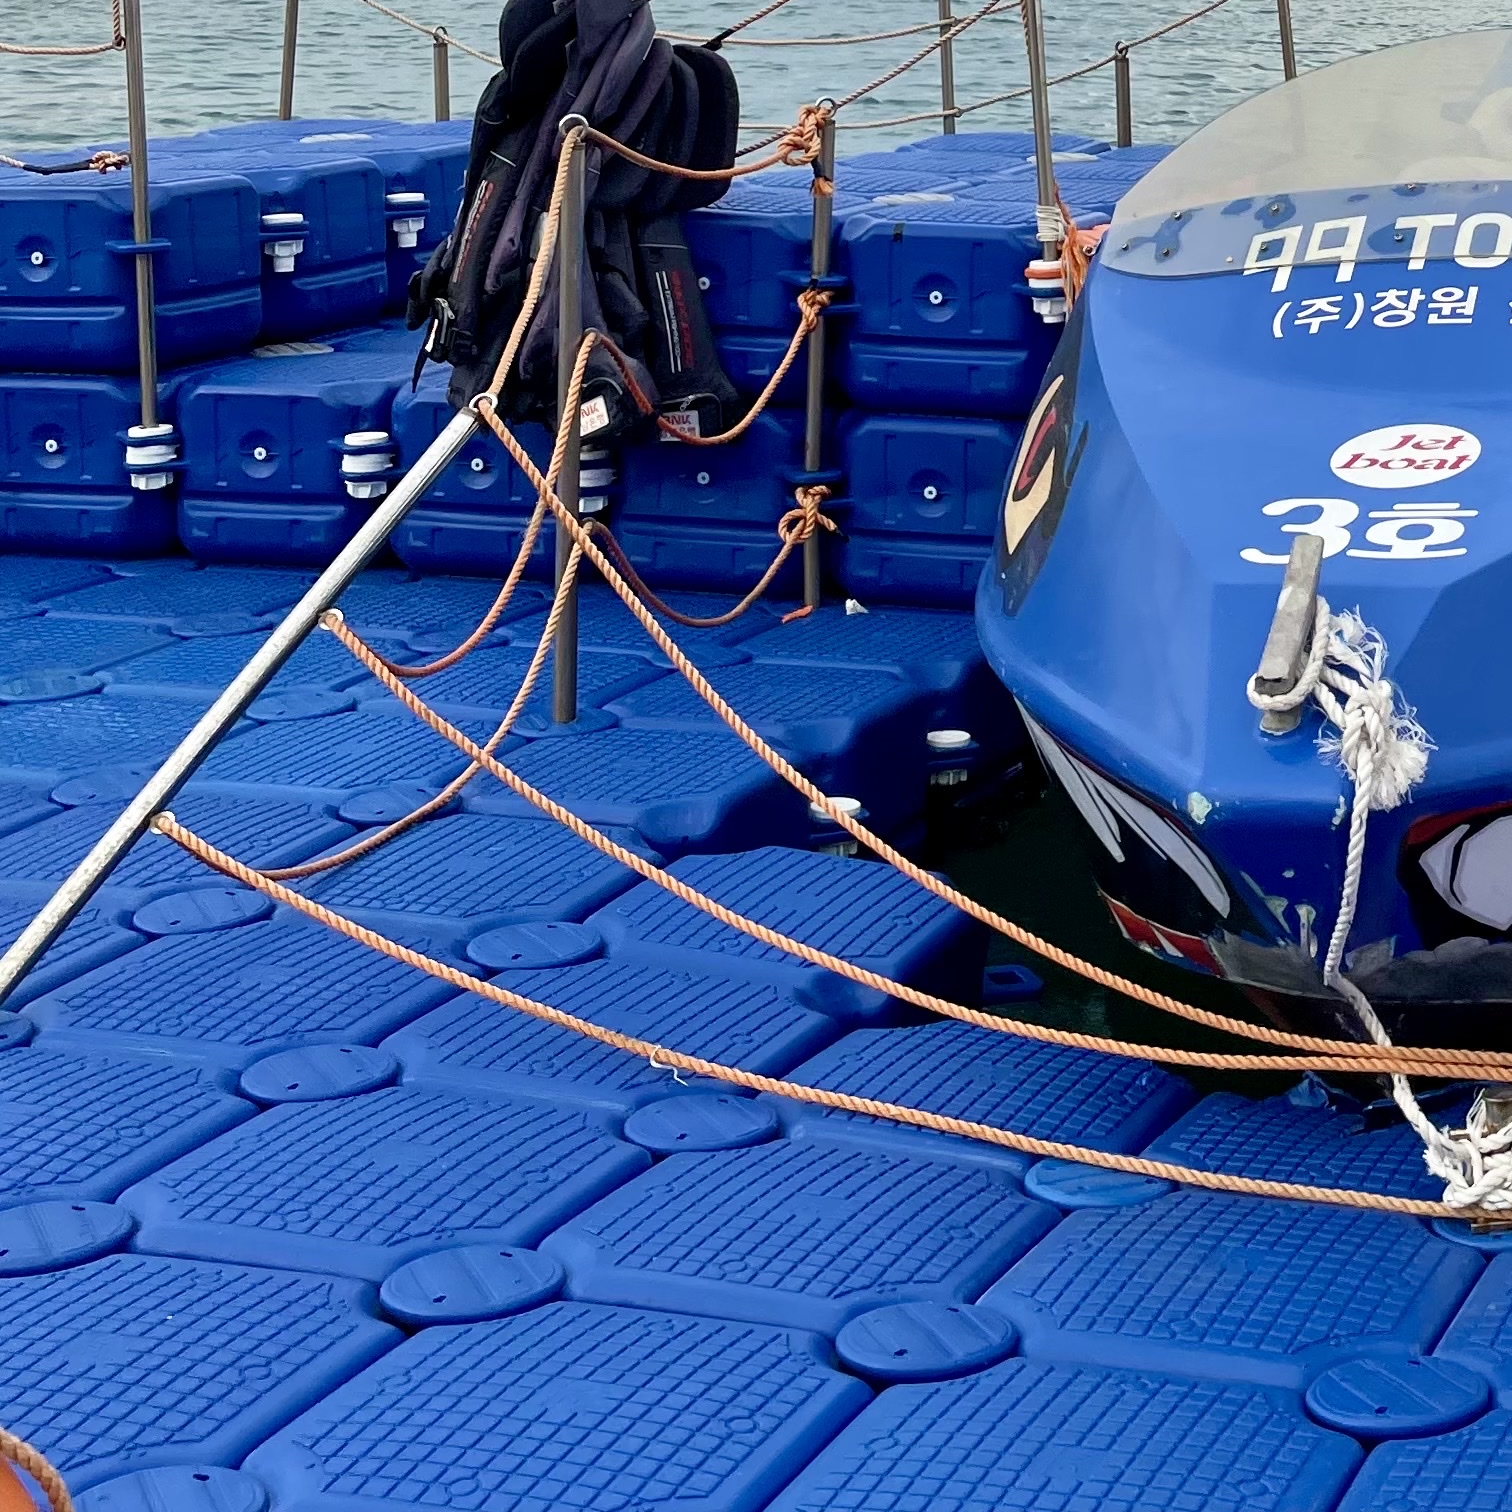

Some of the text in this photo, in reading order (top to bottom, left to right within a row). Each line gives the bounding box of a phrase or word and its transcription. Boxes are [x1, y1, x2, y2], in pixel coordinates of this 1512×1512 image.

[1272, 286, 1479, 338] (주)창원
[580, 402, 600, 418] NK
[1335, 452, 1472, 471] boat
[1239, 497, 1479, 565] 3호
